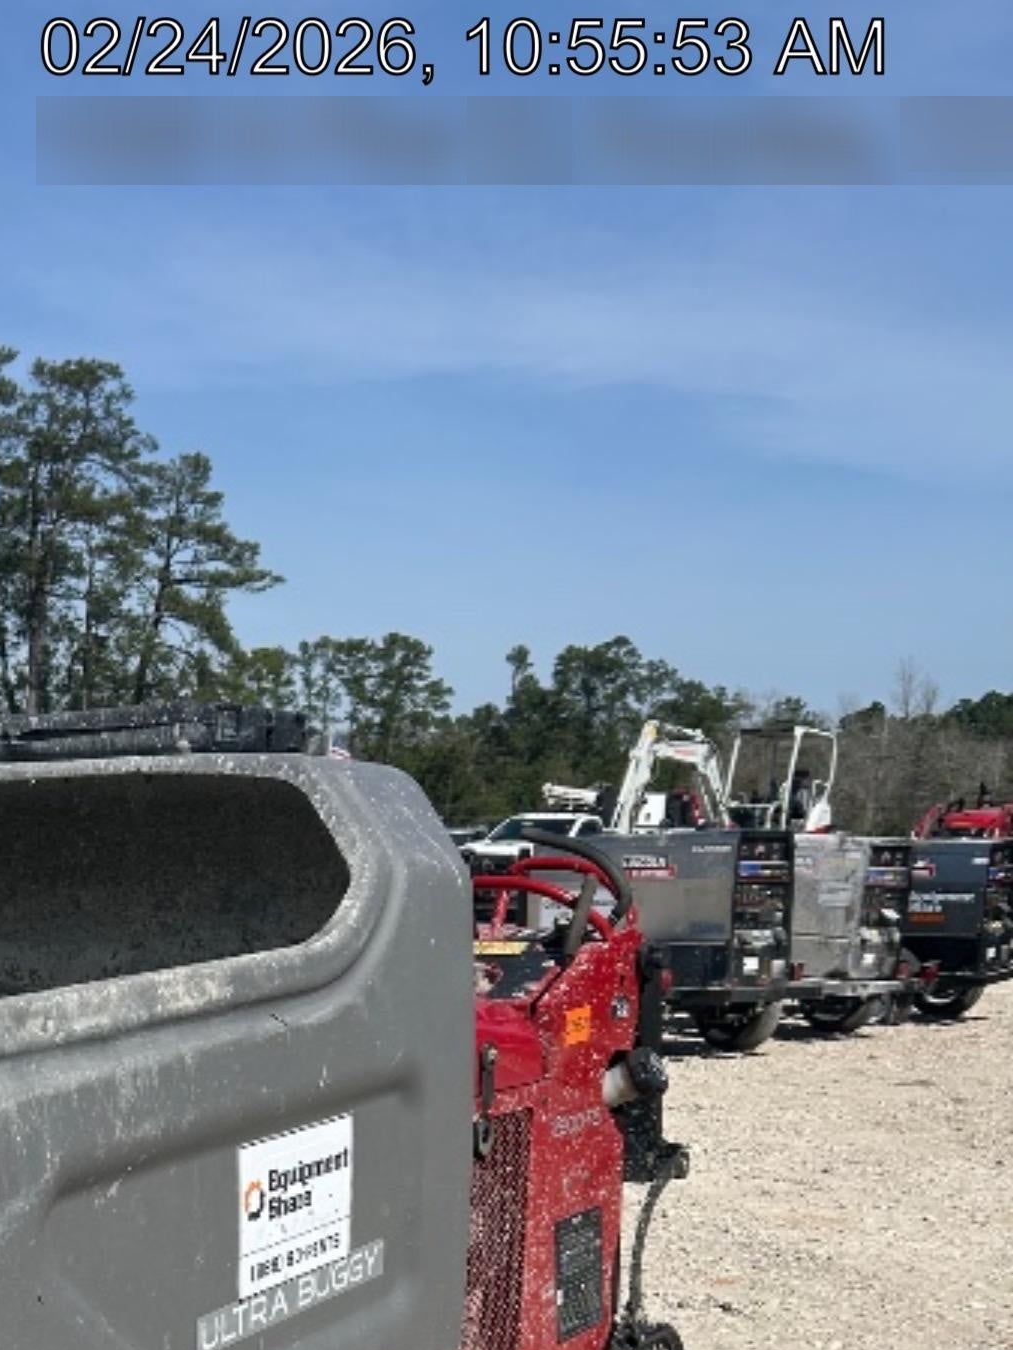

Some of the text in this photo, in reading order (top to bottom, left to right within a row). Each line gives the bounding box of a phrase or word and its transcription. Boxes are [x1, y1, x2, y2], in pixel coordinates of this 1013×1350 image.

[268, 1147, 348, 1192] Equipment
[268, 1190, 312, 1220] Share
[201, 1246, 379, 1350] ULTRA BUGGY
